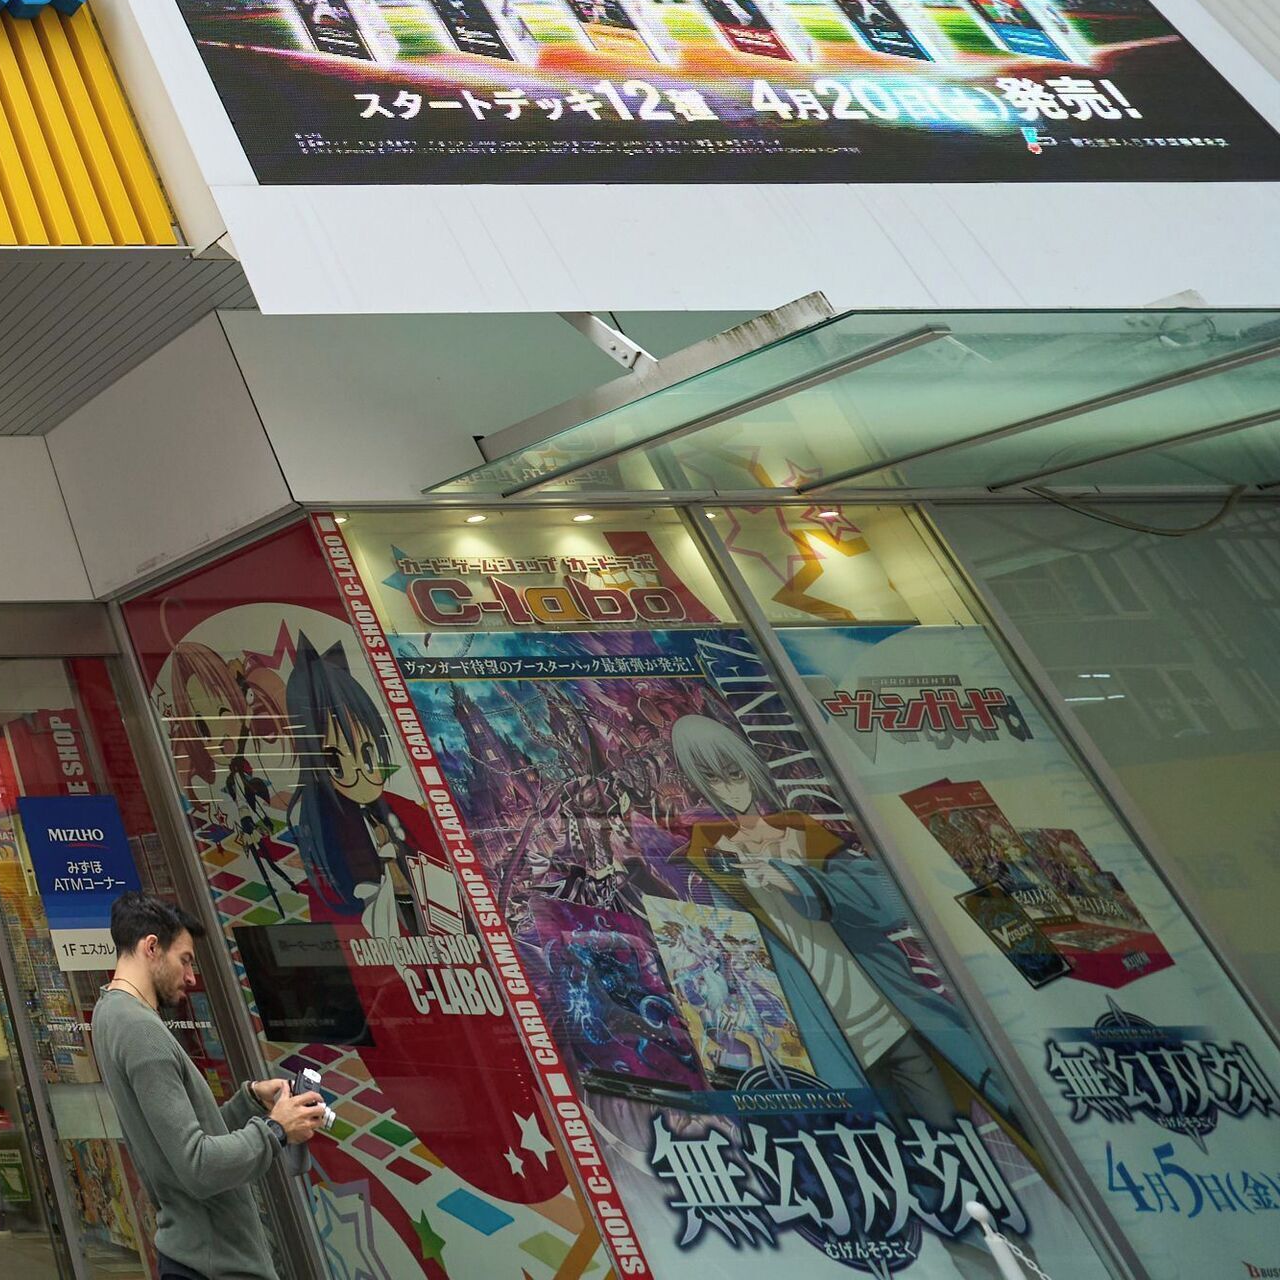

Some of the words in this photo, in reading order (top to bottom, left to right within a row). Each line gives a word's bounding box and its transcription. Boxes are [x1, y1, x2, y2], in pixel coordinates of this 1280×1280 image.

[326, 534, 362, 596] C-LABO
[355, 598, 385, 648] SHOP
[49, 716, 85, 777] SHOP
[395, 706, 432, 760] CARD
[48, 828, 105, 843] MIZUHO
[428, 788, 473, 860] C-LABO
[54, 875, 127, 892] ATMコーナー
[67, 860, 104, 875] みずほ
[61, 943, 77, 957] 1F
[349, 936, 391, 967] CARD
[390, 935, 440, 966] GAME
[440, 933, 483, 966] SHOP
[403, 966, 505, 1017] C-LABO
[519, 996, 560, 1066] CARD
[805, 1091, 855, 1110] PACK
[559, 1108, 613, 1198] C-LABO
[596, 1201, 648, 1279] SHOP
